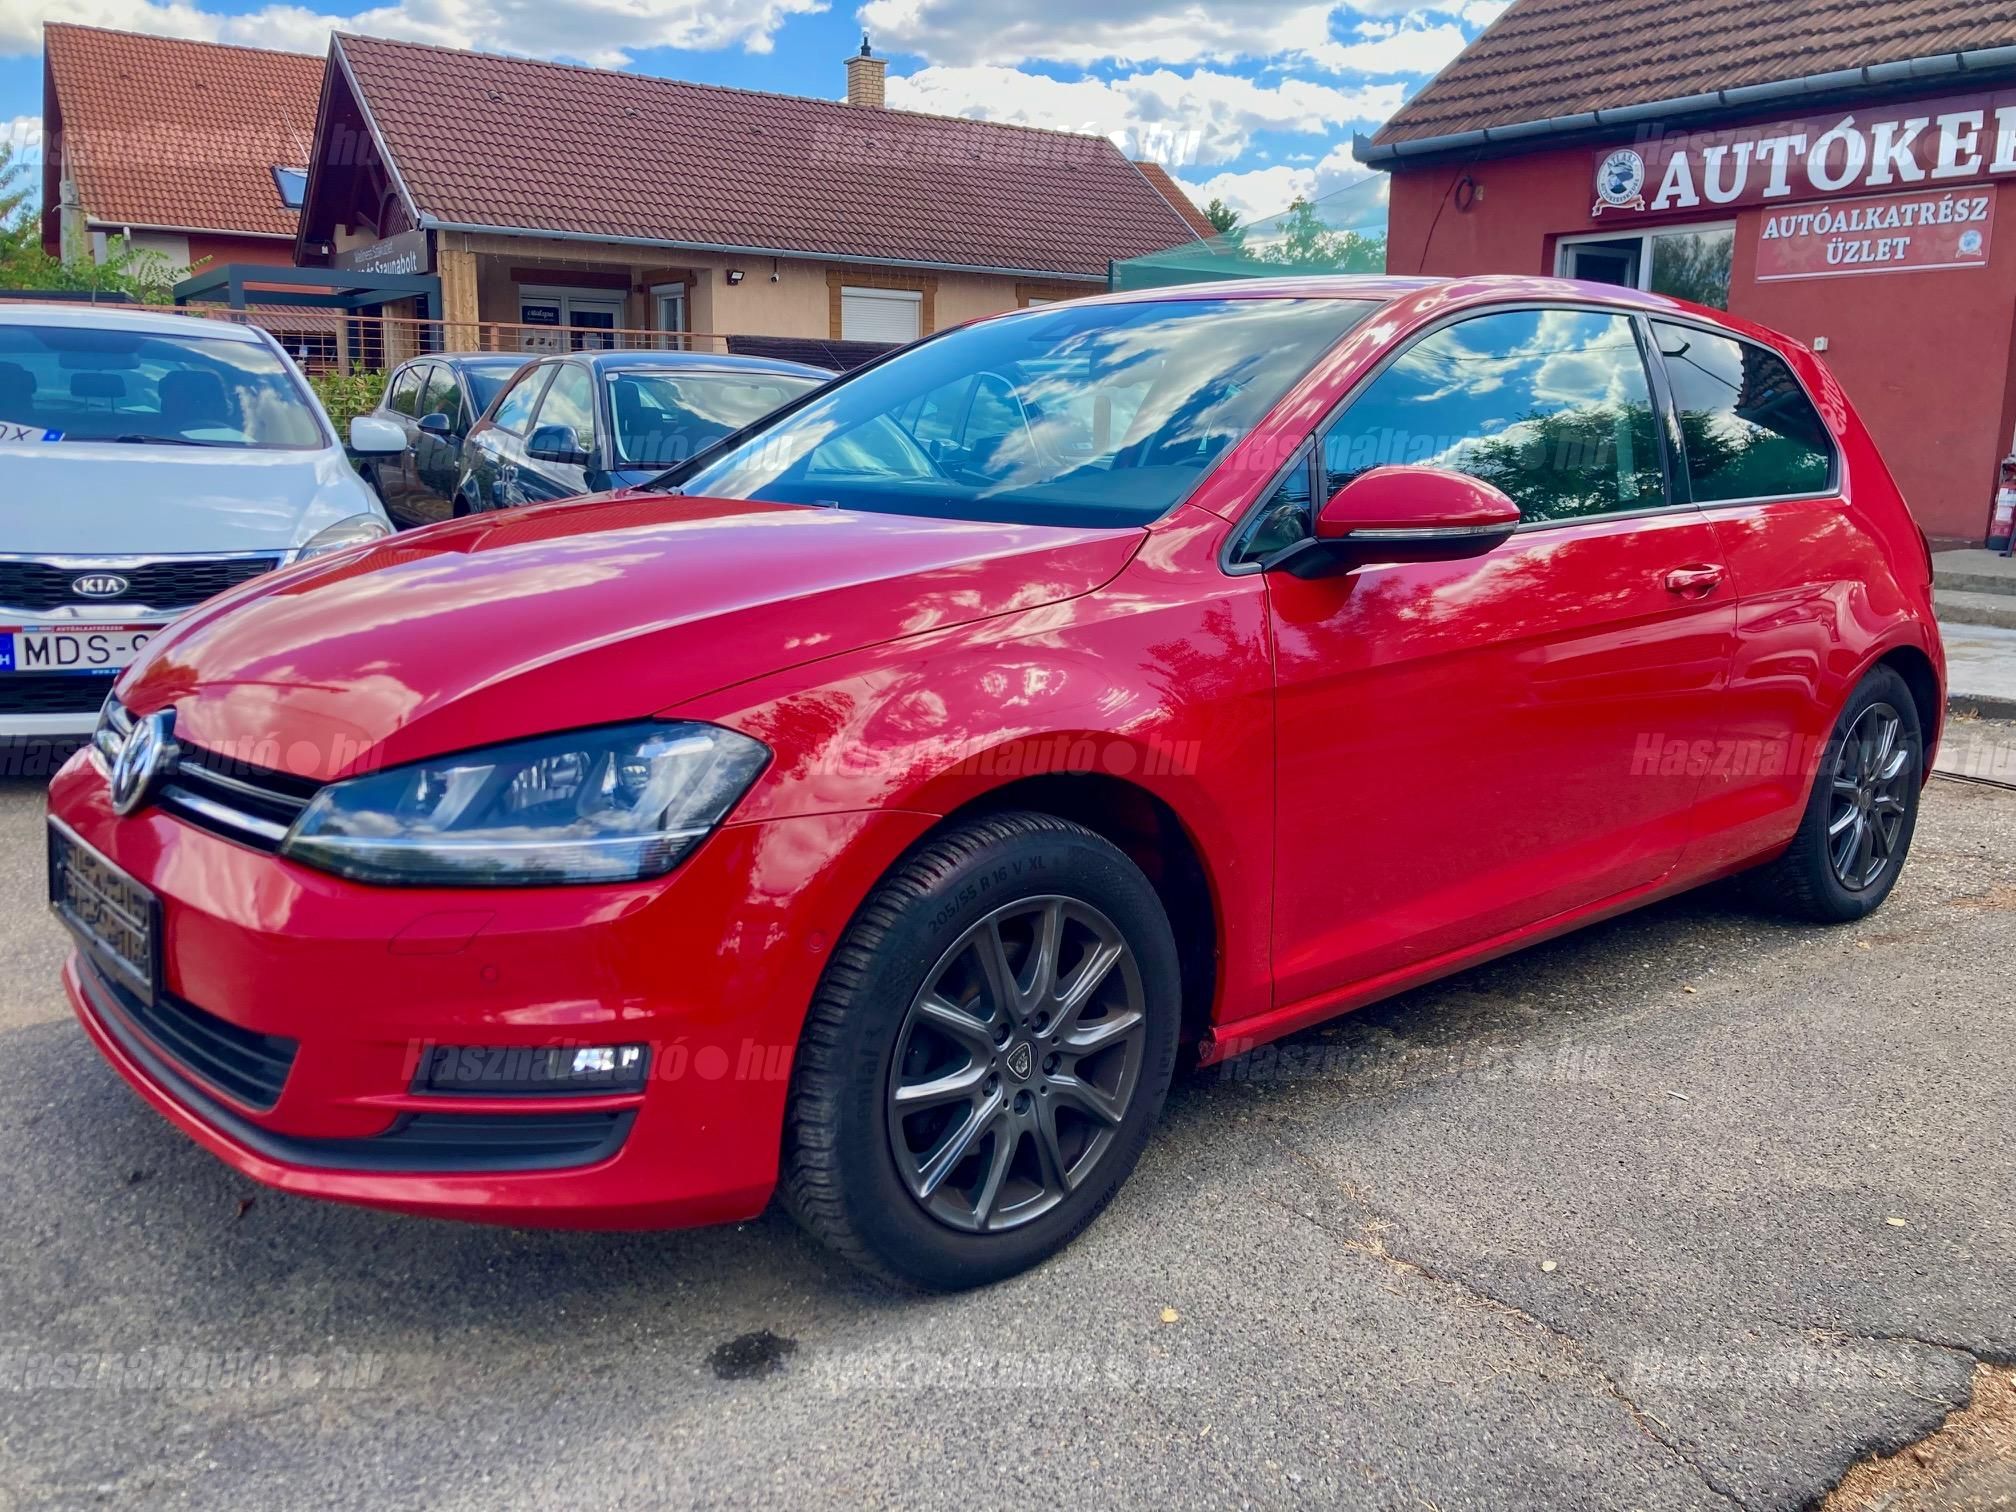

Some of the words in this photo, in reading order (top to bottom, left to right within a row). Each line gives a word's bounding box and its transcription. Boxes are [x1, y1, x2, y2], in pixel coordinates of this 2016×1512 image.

[1762, 194, 1989, 239] AUTÓALKATRÉSZ
[1826, 237, 1911, 265] ÜZLET
[82, 579, 119, 592] KIA
